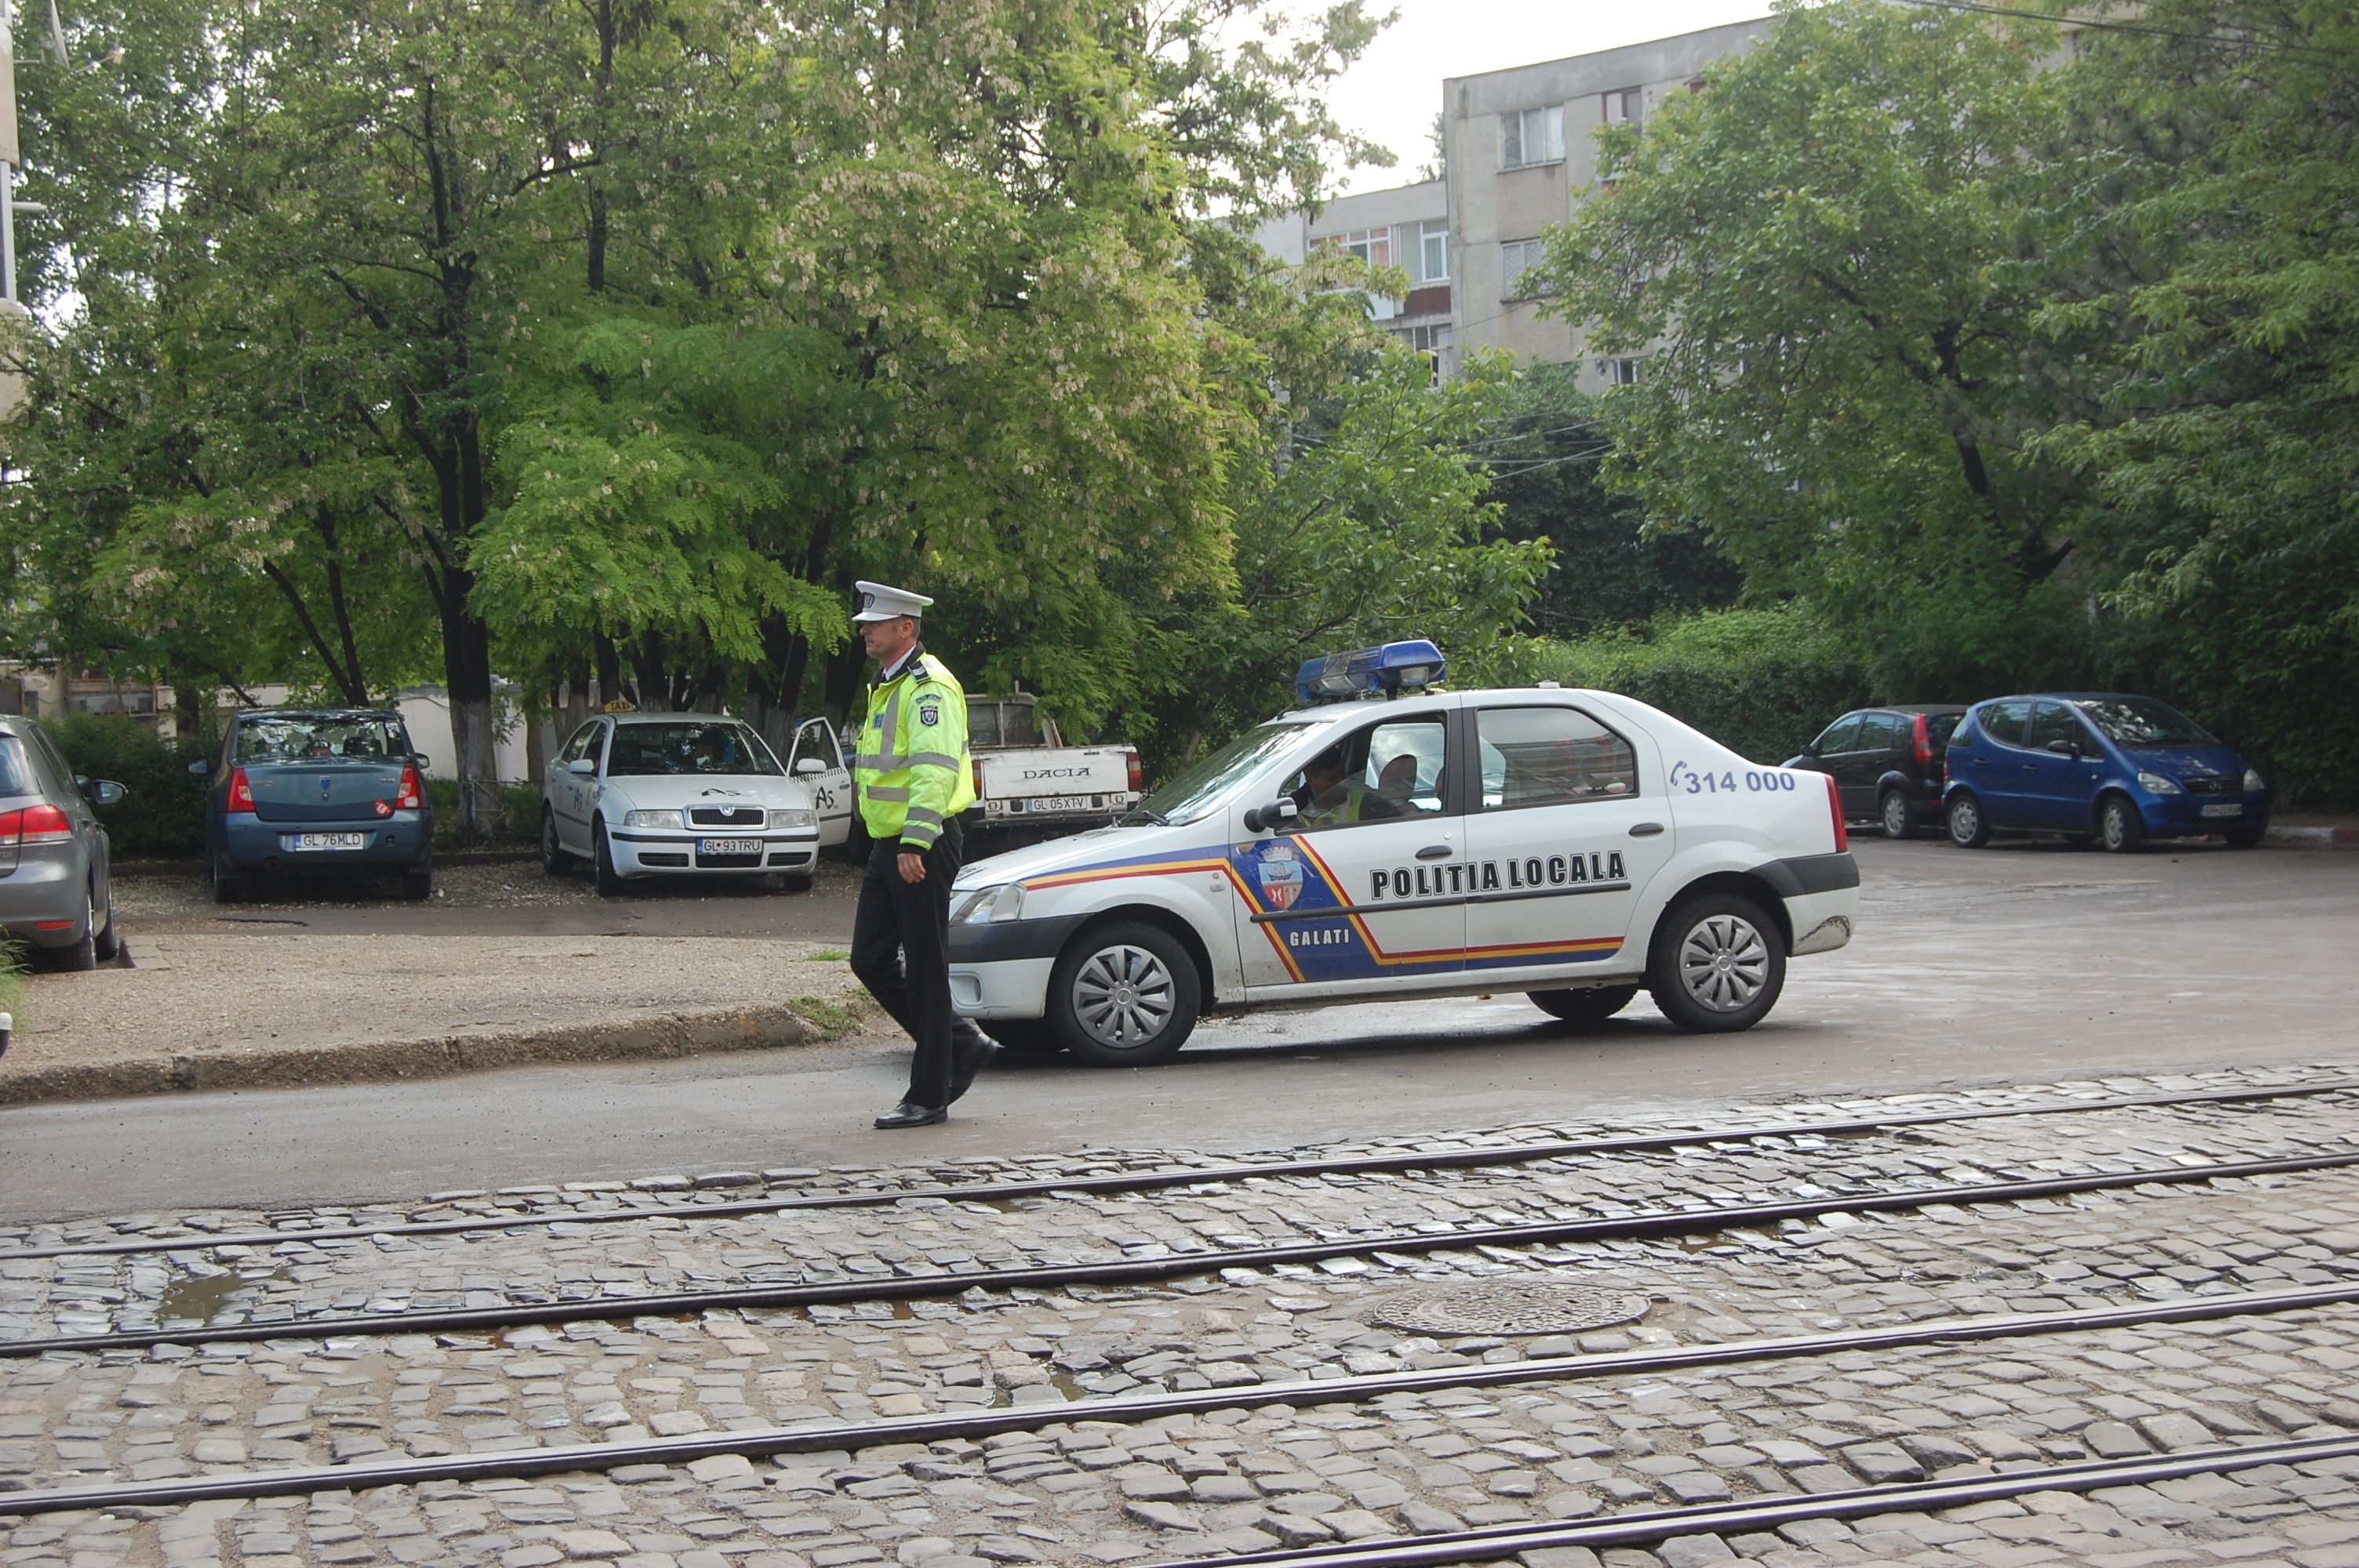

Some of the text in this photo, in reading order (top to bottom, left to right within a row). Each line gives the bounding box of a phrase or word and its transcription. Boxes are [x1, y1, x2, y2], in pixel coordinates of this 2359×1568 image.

[611, 702, 630, 710] TAXI
[1023, 768, 1091, 779] DACIA
[1685, 771, 1795, 793] 314 000
[816, 786, 834, 810] As
[1034, 800, 1047, 810] GL
[304, 835, 318, 846] GL
[704, 840, 718, 851] GL
[1370, 850, 1627, 900] POLITIA LOCALA
[1290, 929, 1350, 947] GALATI
